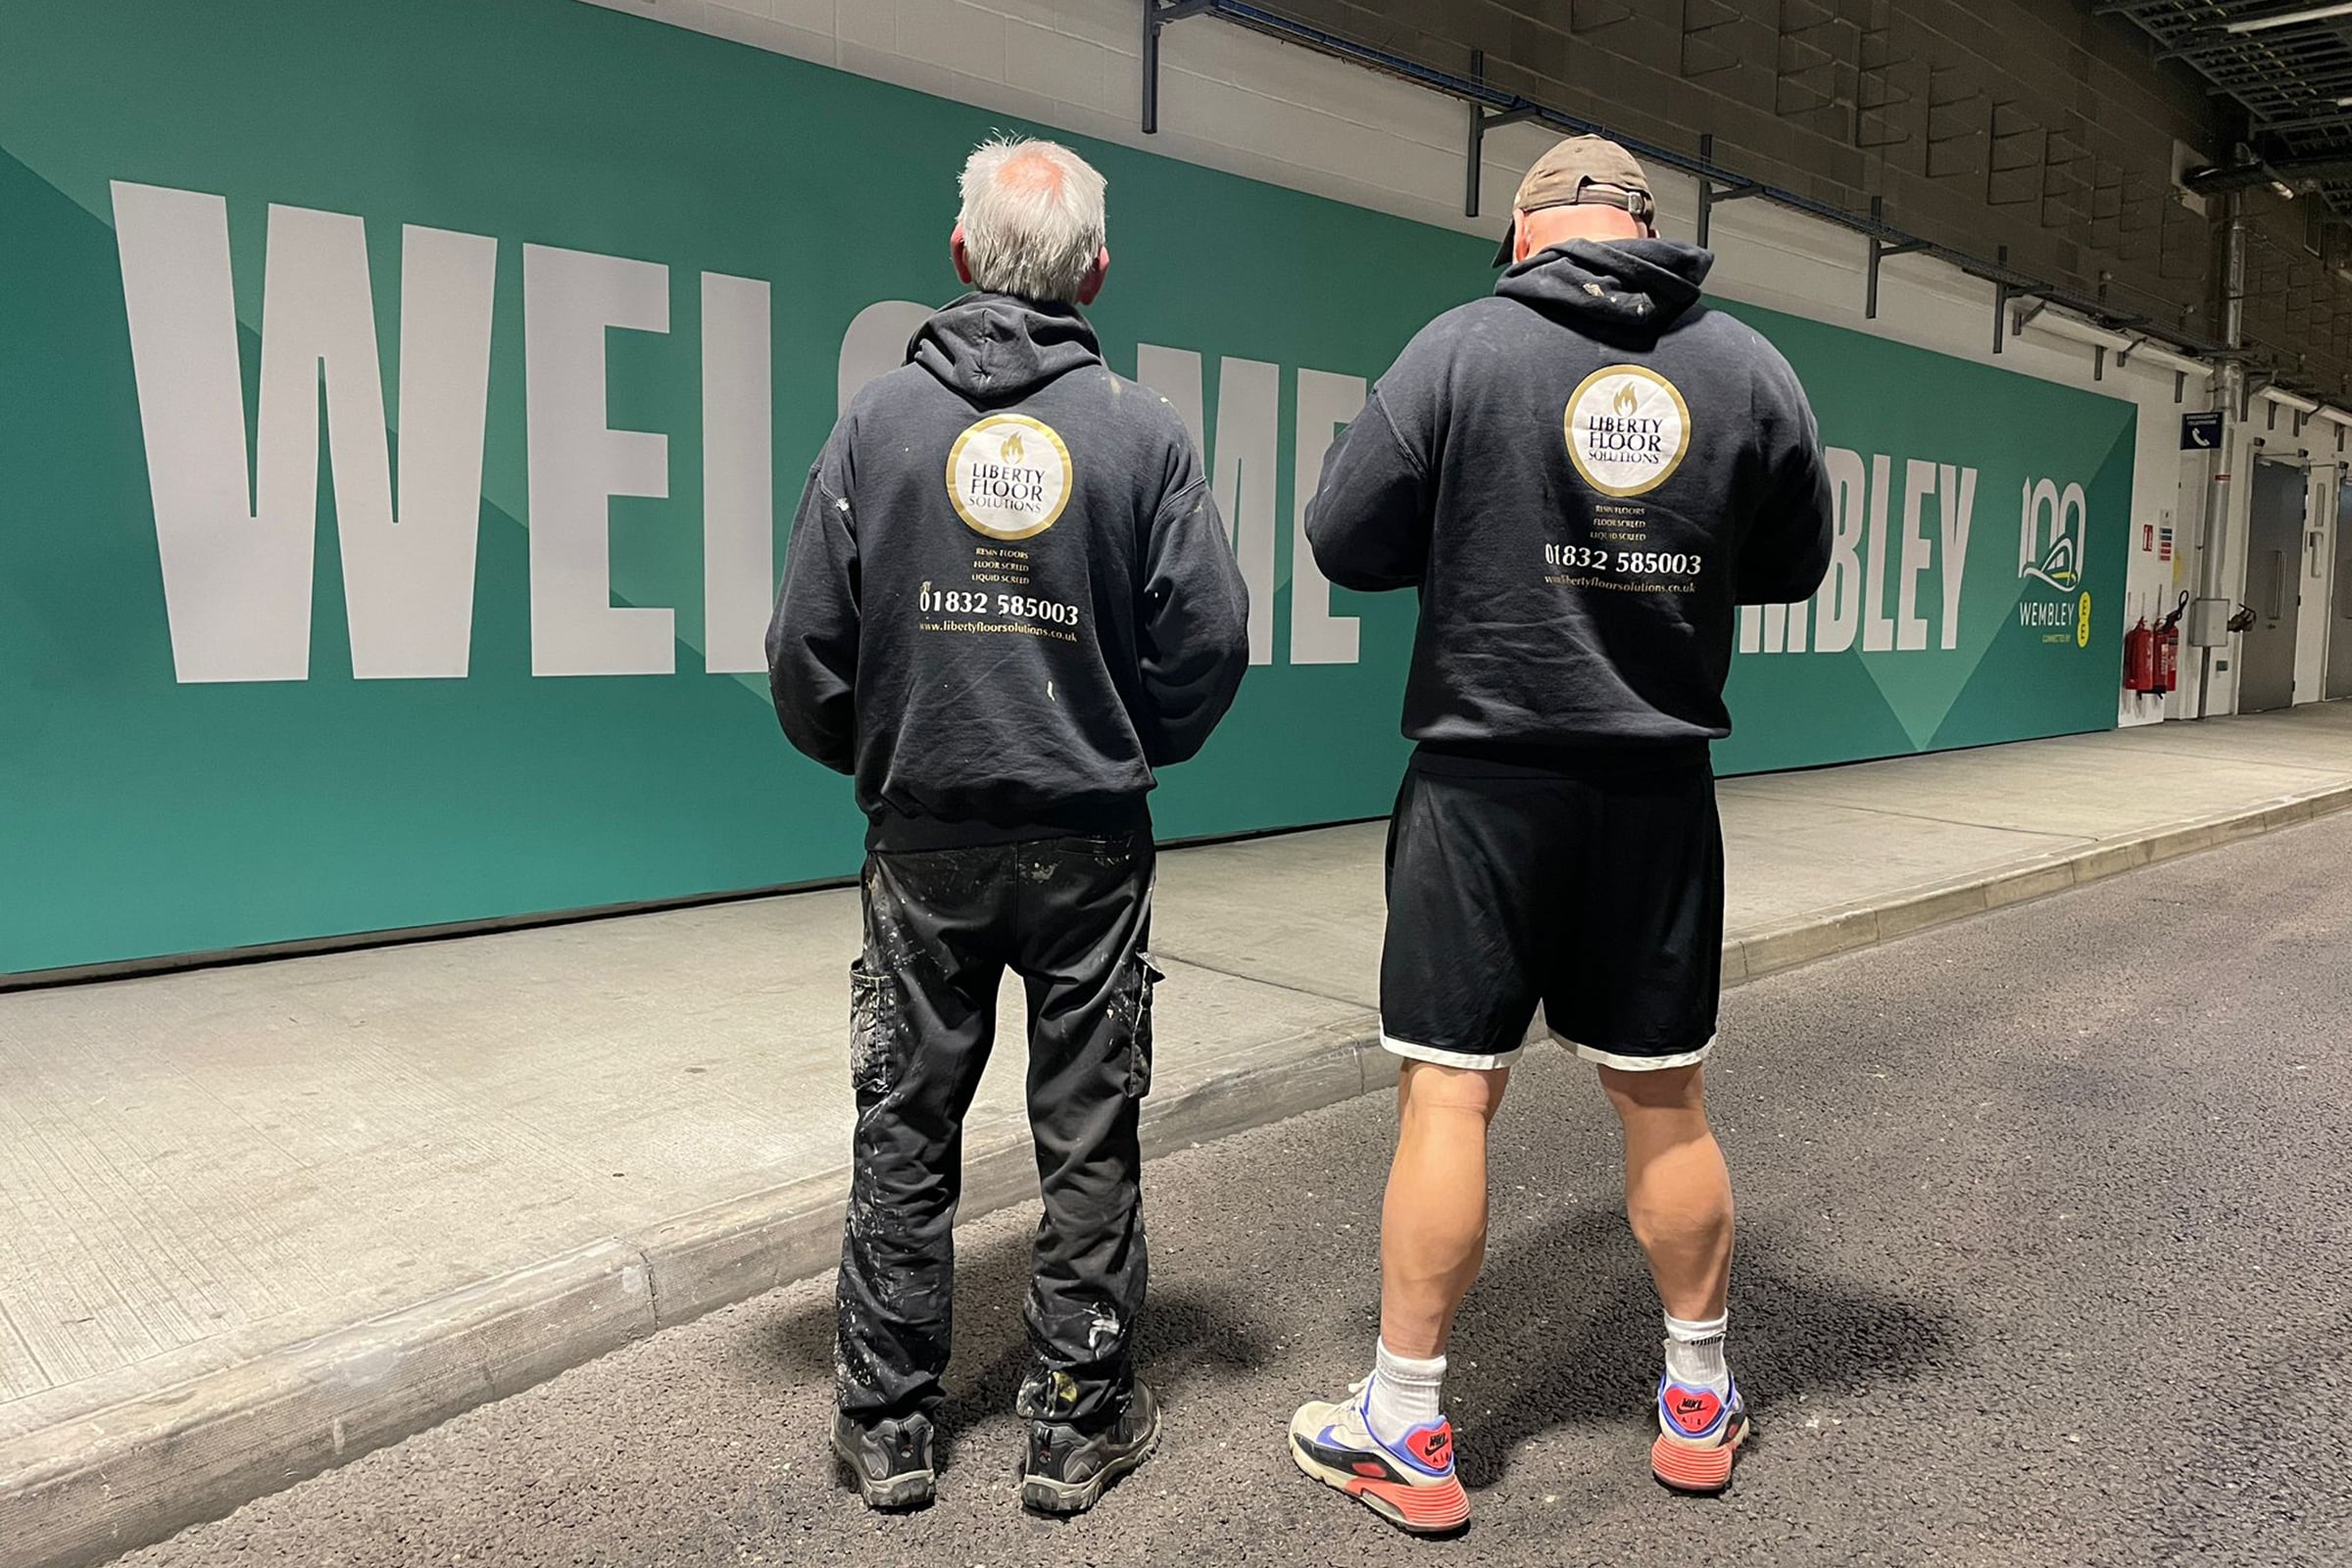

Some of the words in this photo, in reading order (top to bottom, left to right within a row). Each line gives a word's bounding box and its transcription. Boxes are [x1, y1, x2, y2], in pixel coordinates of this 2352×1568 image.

[110, 179, 1366, 683] WELME
[1739, 446, 1978, 654] BLEY
[1589, 416, 1662, 434] LIBERTY
[1589, 431, 1662, 453] FLOOR
[1589, 450, 1660, 465] SOLUTIONS
[972, 463, 1046, 484] LIBERTY
[970, 478, 1044, 502] FLOOR
[968, 496, 1042, 514] SOLUTIONS
[1614, 507, 1645, 515] FLOORS
[973, 561, 1001, 569] FLOOR
[1000, 550, 1029, 560] FLOORS
[1544, 543, 1608, 570] 01832
[1615, 551, 1702, 575] 585003
[971, 573, 1000, 583] LIQUID
[919, 590, 989, 614] 01832
[997, 594, 1079, 626] 585003
[2019, 601, 2076, 626] WEMBLEY
[919, 620, 1078, 643] www.libertyfloorsolutions.co.uk
